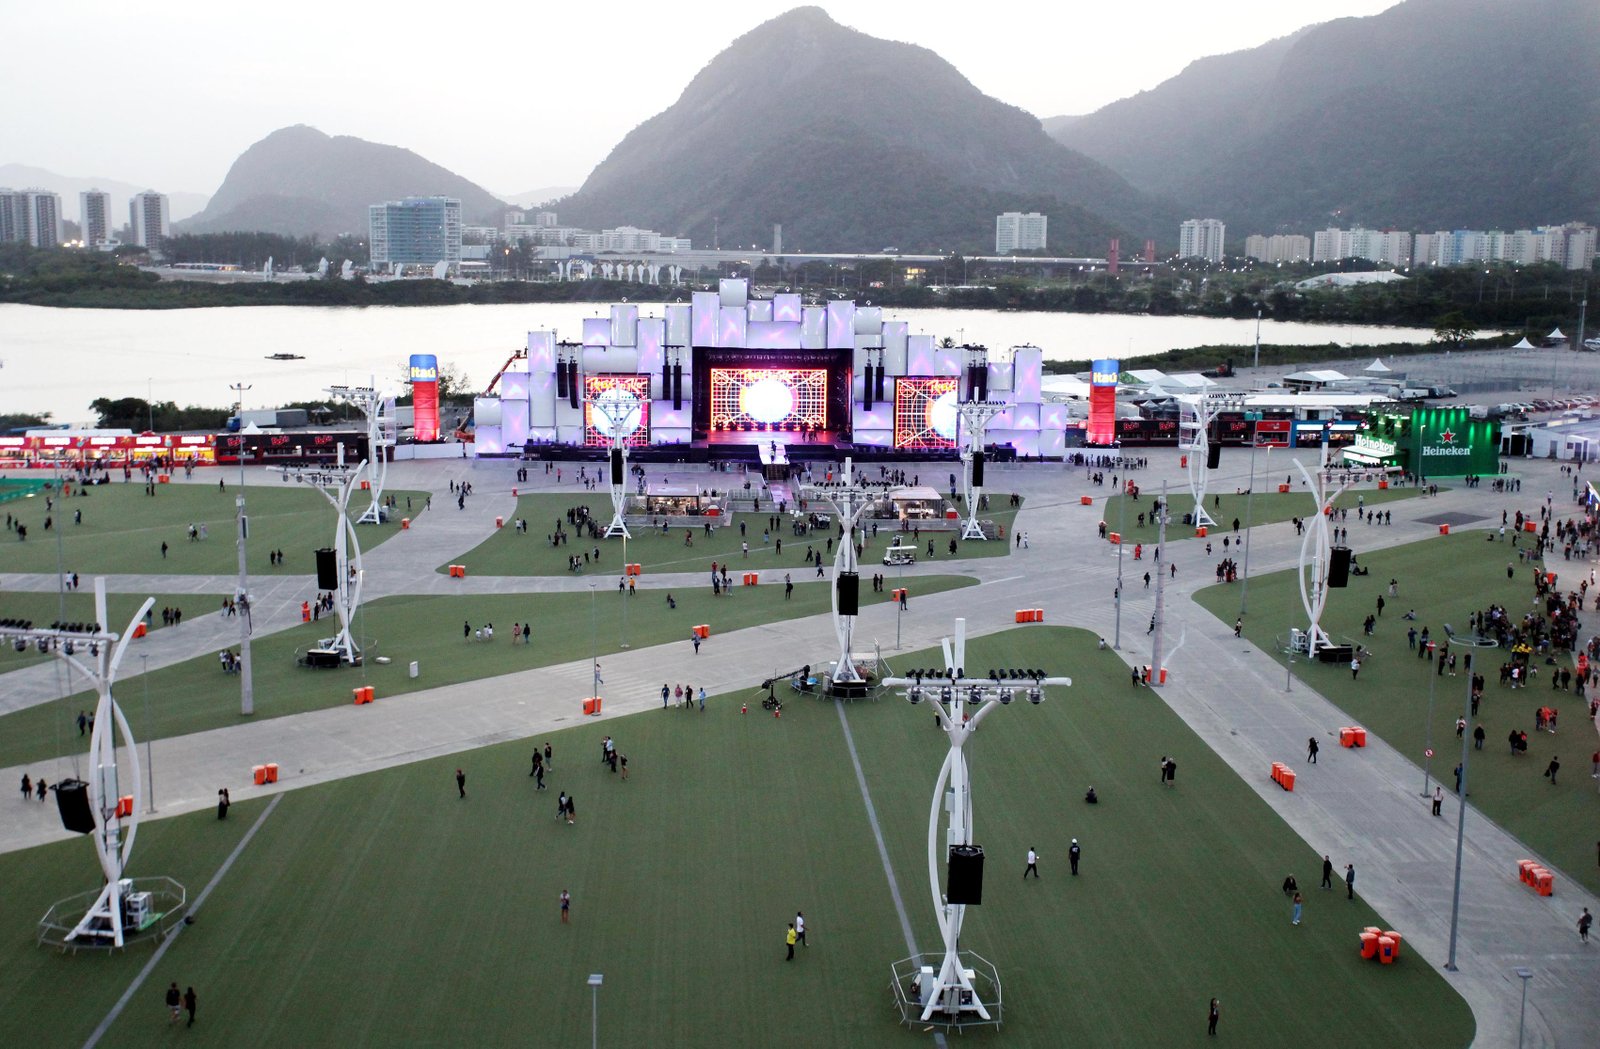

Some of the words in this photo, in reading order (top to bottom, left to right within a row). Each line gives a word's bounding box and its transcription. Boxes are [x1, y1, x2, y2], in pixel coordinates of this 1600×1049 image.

[411, 366, 436, 378] Itaú
[1093, 371, 1118, 383] Itaú
[1355, 433, 1396, 455] Heineken
[1422, 446, 1471, 456] Heineken
